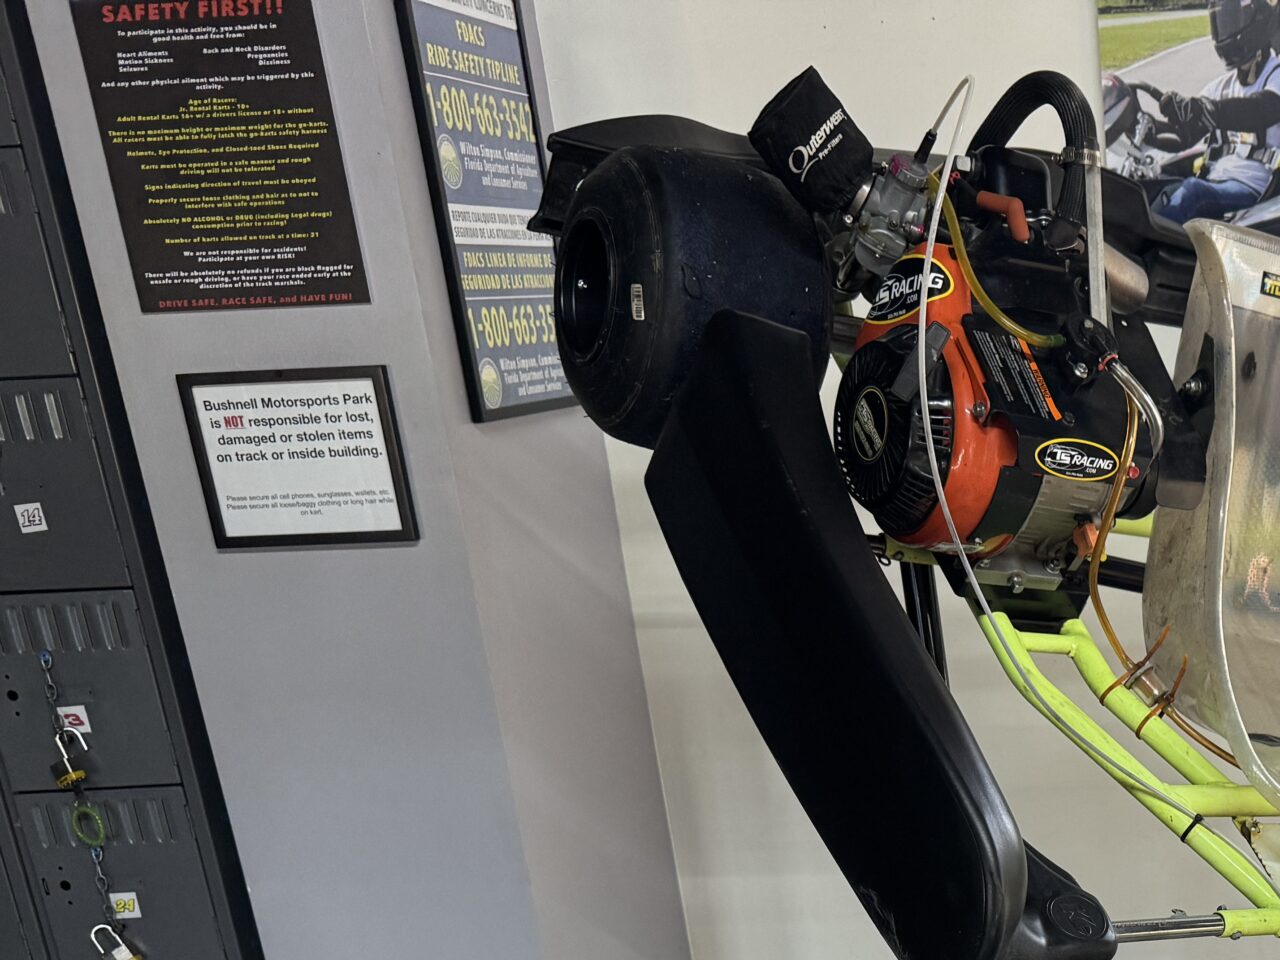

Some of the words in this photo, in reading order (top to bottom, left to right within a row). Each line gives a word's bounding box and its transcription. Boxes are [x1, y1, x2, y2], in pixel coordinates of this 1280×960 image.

[101, 2, 188, 21] SAFETY
[198, 0, 282, 17] FIRST!!
[126, 28, 165, 36] participate
[190, 26, 218, 34] activity,
[456, 20, 485, 46] FDACS
[426, 43, 452, 68] RIDE
[452, 50, 485, 76] SAFETY
[486, 59, 520, 85] TIPLINE
[426, 83, 536, 143] 1-800-663-3542
[463, 252, 485, 268] FDACS
[485, 253, 507, 268] LINEA
[507, 253, 517, 268] DE
[461, 274, 501, 290] SEGURIDAD
[501, 274, 511, 289] DE
[510, 274, 523, 289] LAS
[191, 298, 218, 306] SAFE,
[221, 297, 246, 305] RACE
[249, 295, 276, 304] SAFE,
[329, 292, 352, 300] FUN!
[468, 304, 555, 349] 1-800-663-35
[202, 398, 258, 411] Bushnell
[260, 394, 339, 410] Motorsports
[342, 392, 372, 404] Park
[209, 417, 221, 429] is
[223, 415, 246, 429] NOT
[248, 413, 321, 428] responsible
[324, 411, 342, 423] for
[345, 410, 373, 424] lost,
[217, 432, 276, 447] damaged
[279, 434, 293, 442] or
[295, 429, 335, 442] stolen
[337, 427, 373, 439] items
[216, 453, 232, 462] on
[234, 450, 268, 461] track
[270, 451, 284, 460] or
[286, 447, 325, 459] inside
[327, 444, 382, 460] building.
[1072, 454, 1114, 471] RACING
[21, 508, 42, 528] 14
[64, 713, 85, 727] 3
[115, 898, 135, 913] 24
